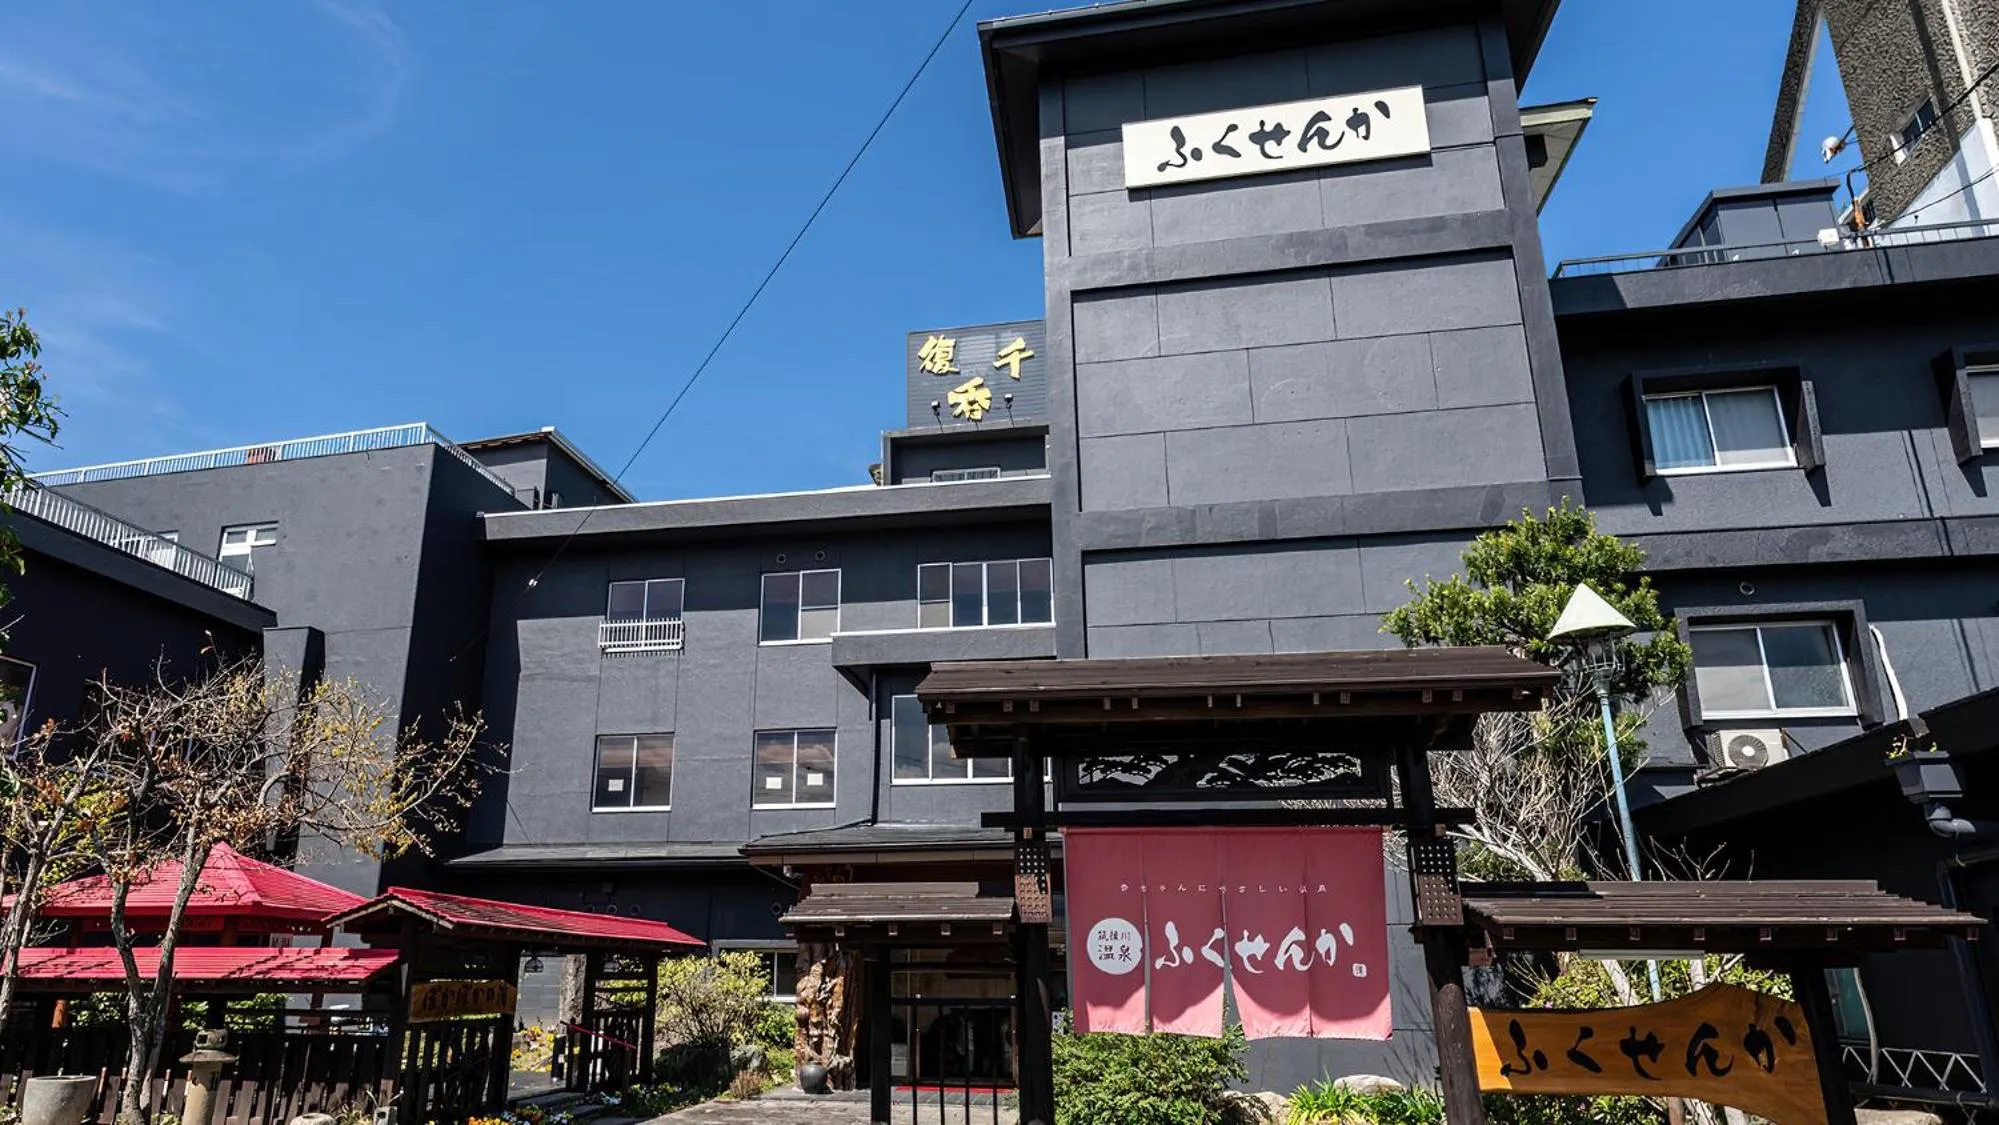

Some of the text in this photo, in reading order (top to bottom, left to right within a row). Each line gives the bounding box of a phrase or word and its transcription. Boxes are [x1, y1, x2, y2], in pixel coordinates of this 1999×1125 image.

[1157, 100, 1391, 172] ふくせんか
[1098, 944, 1132, 962] 温泉
[1154, 920, 1355, 975] ふくせんか
[1500, 1016, 1796, 1081] ふくせんか
